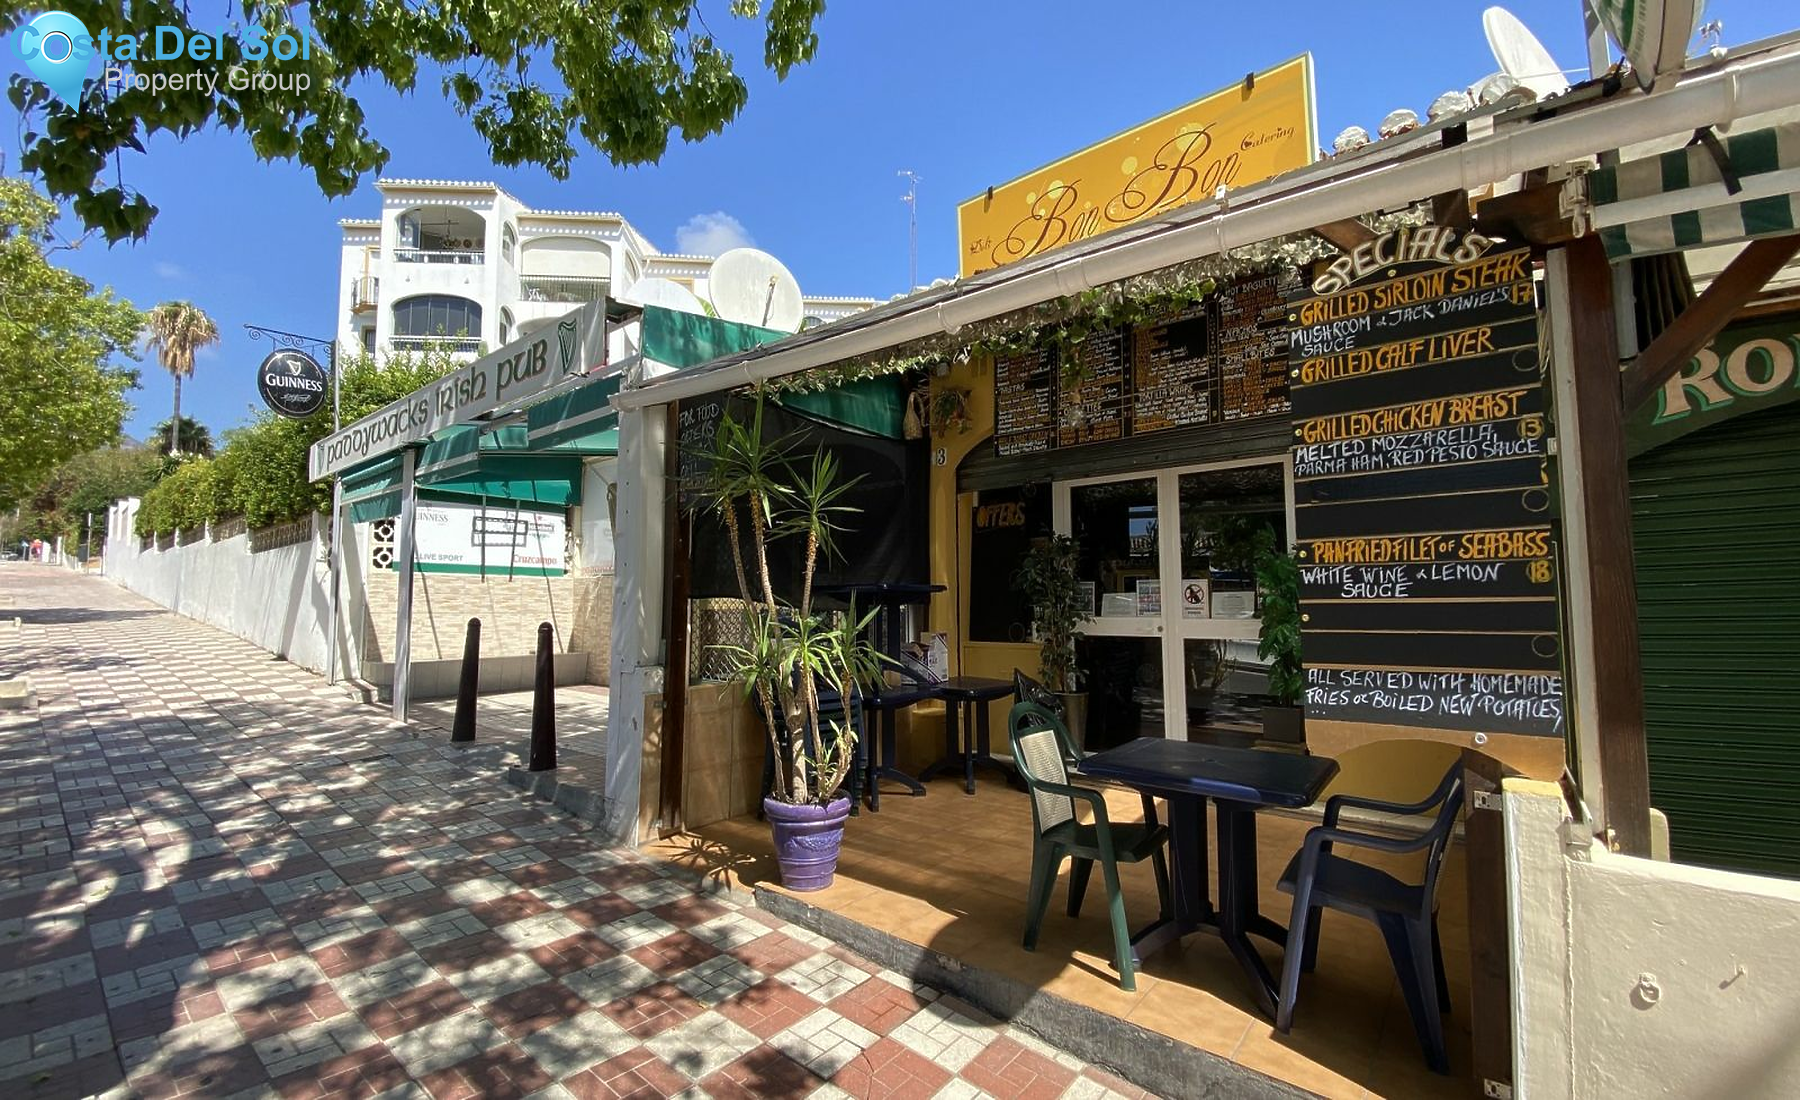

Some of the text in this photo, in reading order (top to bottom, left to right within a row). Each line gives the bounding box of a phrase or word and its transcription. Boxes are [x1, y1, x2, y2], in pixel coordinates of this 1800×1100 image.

[992, 179, 1101, 268] Bon
[1104, 122, 1242, 223] Bon
[1311, 226, 1495, 296] SPECIALS
[1301, 290, 1369, 326] GRILLED
[1373, 272, 1447, 309] SIRLOIN
[1453, 252, 1530, 291] STEAK
[1291, 316, 1371, 349] MUSHROOM
[1388, 304, 1435, 326] JACK
[1437, 287, 1510, 316] DANIEL'S
[1511, 284, 1534, 304] 17
[1301, 335, 1356, 358] SAUCE
[1301, 327, 1495, 384] GRILLED CALF LIVER
[265, 373, 323, 392] GUINNESS
[1653, 333, 1800, 425] RO
[1303, 390, 1527, 443] GRILLED CHICKEN BREAST
[1295, 456, 1347, 477] PARMA
[1388, 448, 1424, 467] RED
[1428, 443, 1477, 463] PESTO
[1482, 438, 1541, 458] SAUCE
[1296, 439, 1365, 464] MELTED
[1372, 424, 1498, 452] MOZZARELLA,
[976, 502, 1026, 528] OFFERS
[437, 554, 464, 562] SPORT
[1393, 536, 1441, 561] FILET
[1300, 565, 1355, 585] WHITE
[1359, 565, 1408, 583] WINE
[1431, 562, 1506, 582] LEMON
[1341, 582, 1413, 598] SAUCE
[1308, 669, 1563, 696] ALL SERVED WITH HOMEMADE
[1305, 687, 1351, 706] FRIES
[1369, 690, 1434, 712] BOILED
[1439, 693, 1479, 716] NEW
